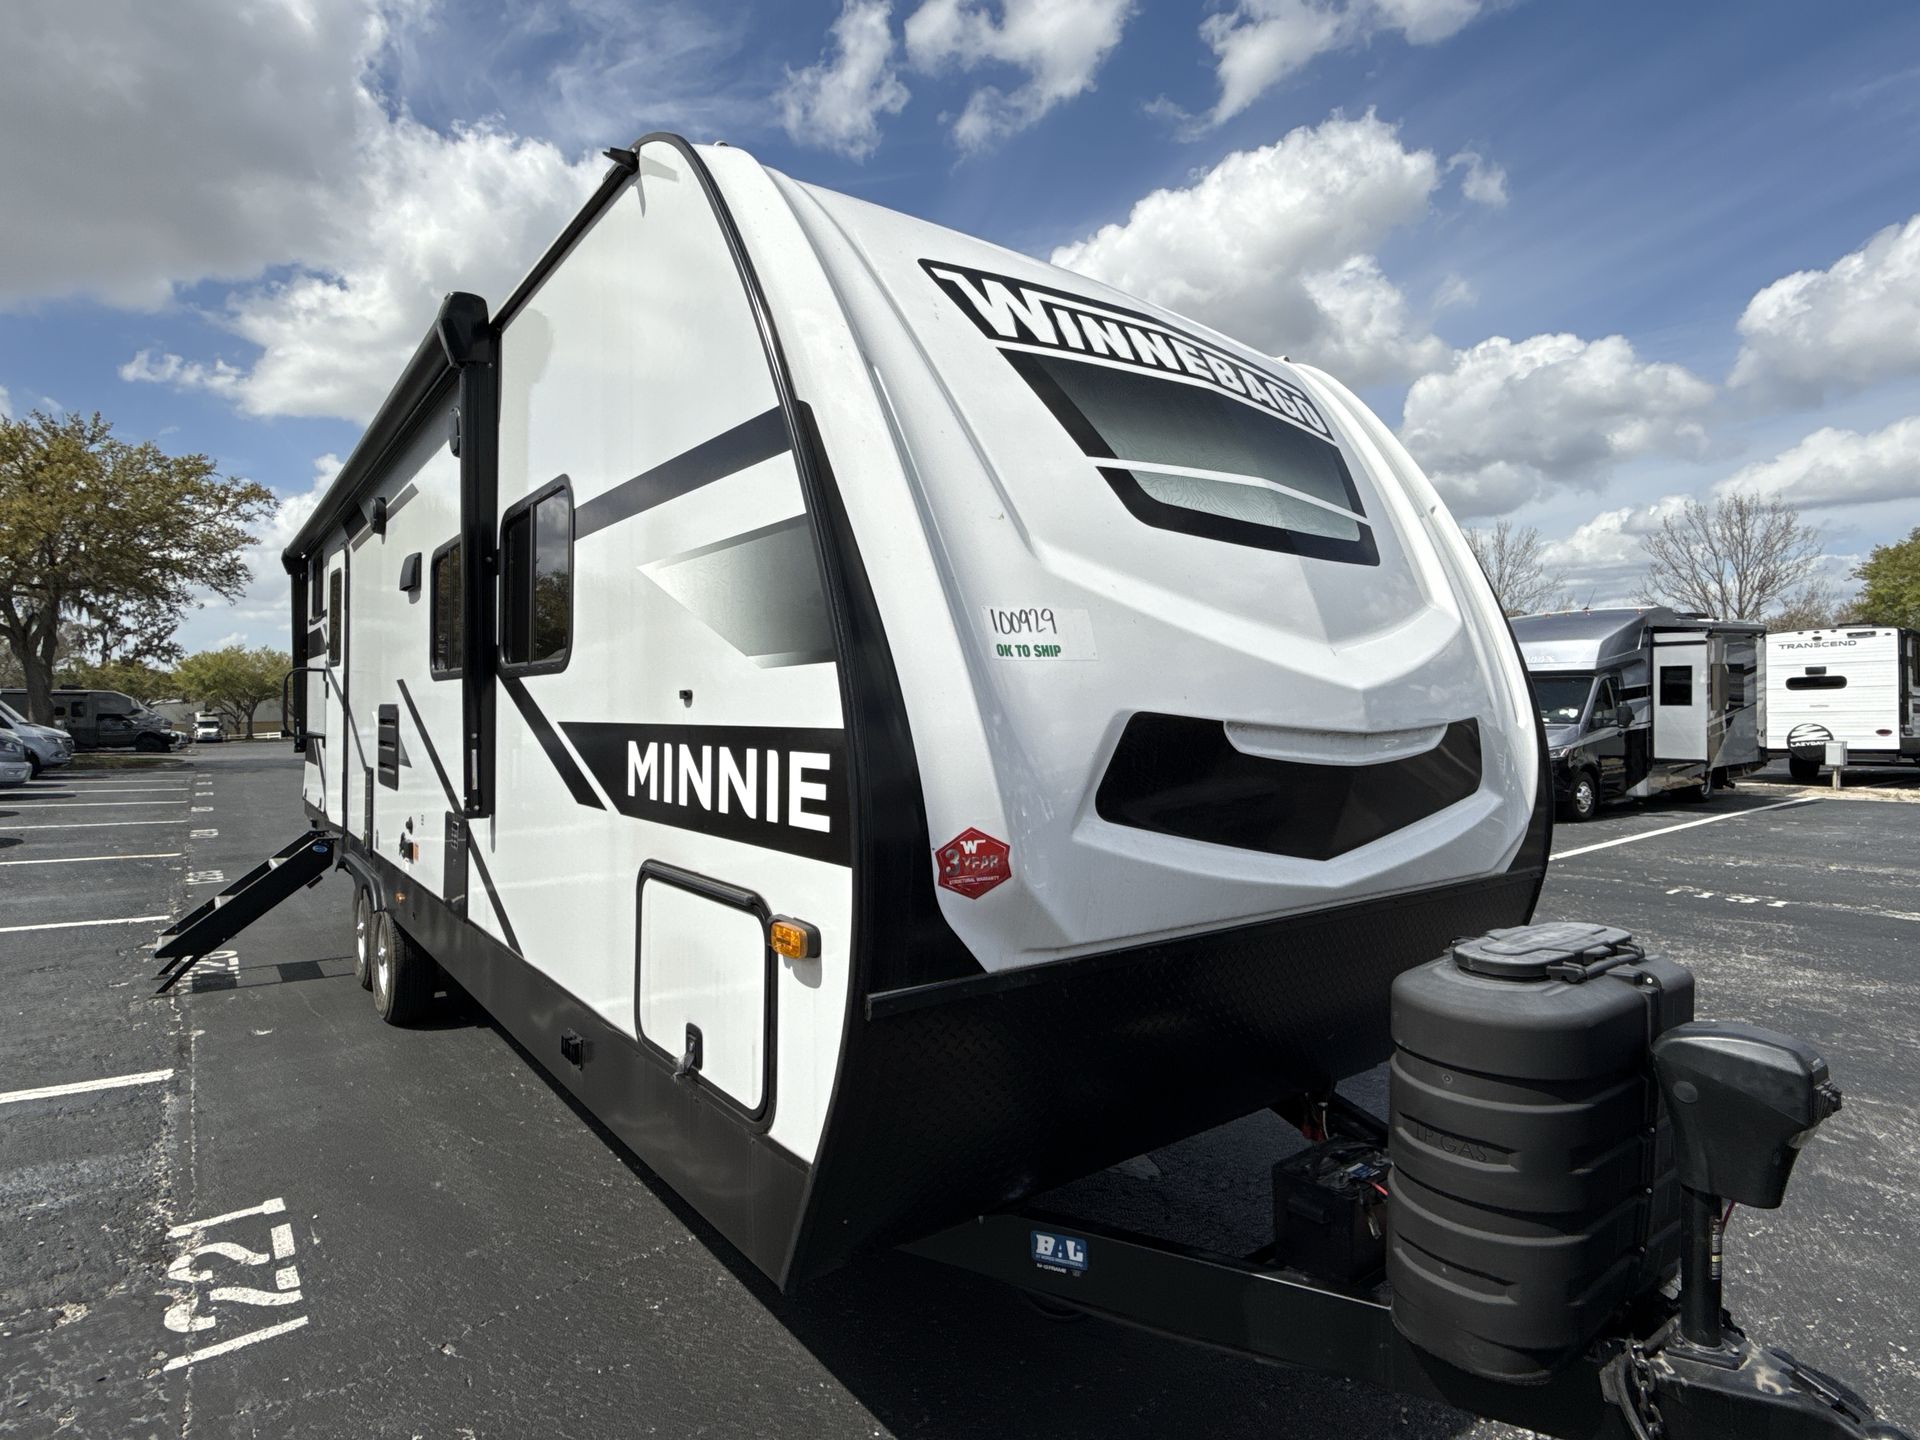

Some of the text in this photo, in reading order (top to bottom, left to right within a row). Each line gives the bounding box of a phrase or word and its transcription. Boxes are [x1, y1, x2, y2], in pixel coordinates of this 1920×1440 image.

[930, 267, 1328, 435] WINNEBAGO
[990, 608, 1058, 635] 100929
[996, 643, 1062, 658] OK TO SHIP
[1778, 640, 1857, 650] TRANSCEND
[627, 740, 831, 833] MINNIE
[945, 849, 999, 875] 3 YEAR
[1440, 1134, 1488, 1161] GAS
